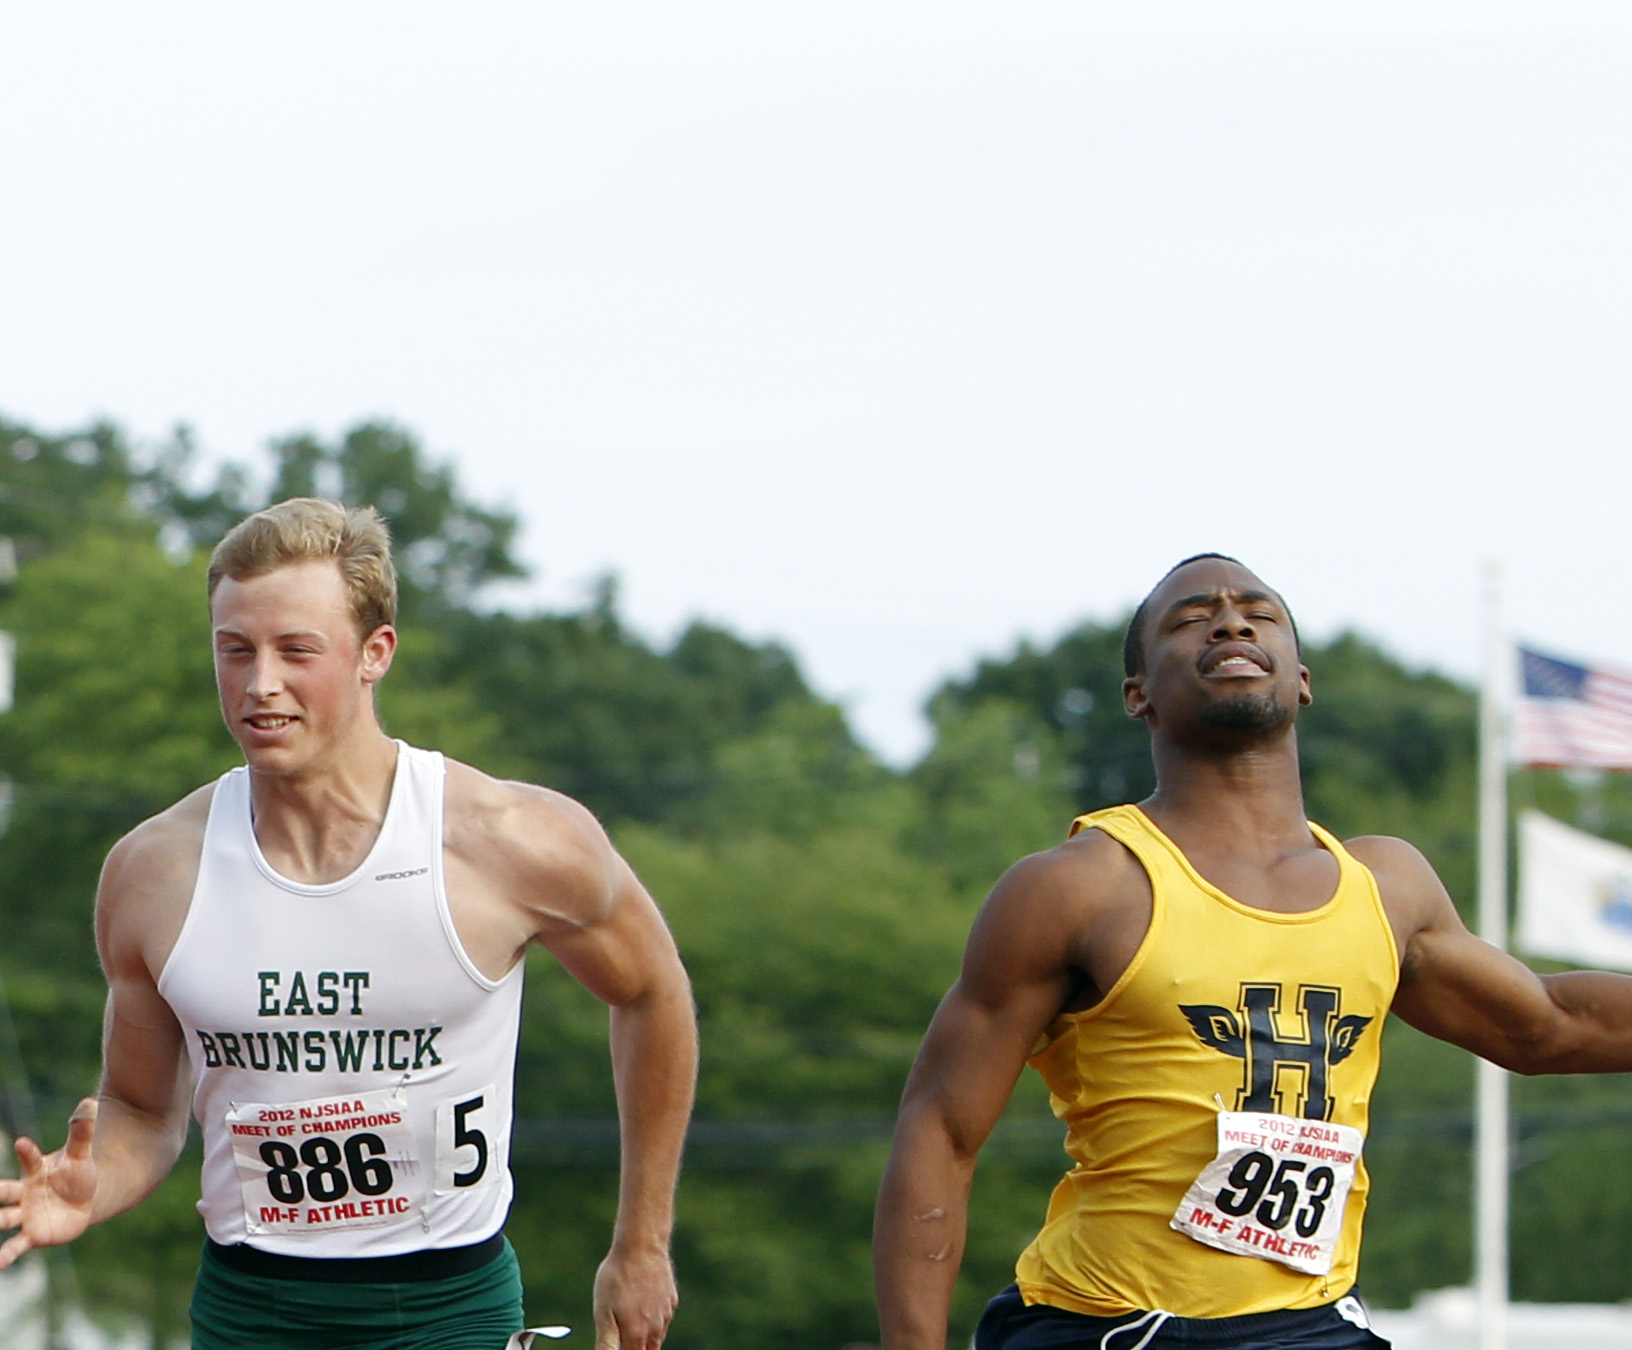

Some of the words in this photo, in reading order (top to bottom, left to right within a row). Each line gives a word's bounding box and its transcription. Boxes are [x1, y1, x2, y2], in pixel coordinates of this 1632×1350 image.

[257, 971, 370, 1017] EAST
[196, 1026, 444, 1073] BRUNSWICK
[1236, 982, 1341, 1121] H
[232, 1123, 272, 1137] MEET
[277, 1126, 296, 1137] OF
[301, 1112, 402, 1134] CHAMPIONS
[258, 1107, 296, 1122] 2012
[299, 1100, 365, 1119] NJSIAA
[1258, 1118, 1295, 1136] 2012
[453, 1096, 488, 1188] 5
[1224, 1130, 1268, 1147] MEET
[1271, 1138, 1291, 1152] OF
[258, 1132, 394, 1204] 886
[260, 1206, 300, 1223] M-F
[307, 1197, 411, 1224] ATHLETIC
[1215, 1151, 1335, 1238] 953
[1190, 1208, 1232, 1235] M-F
[1237, 1225, 1321, 1261] ATHLETIC
